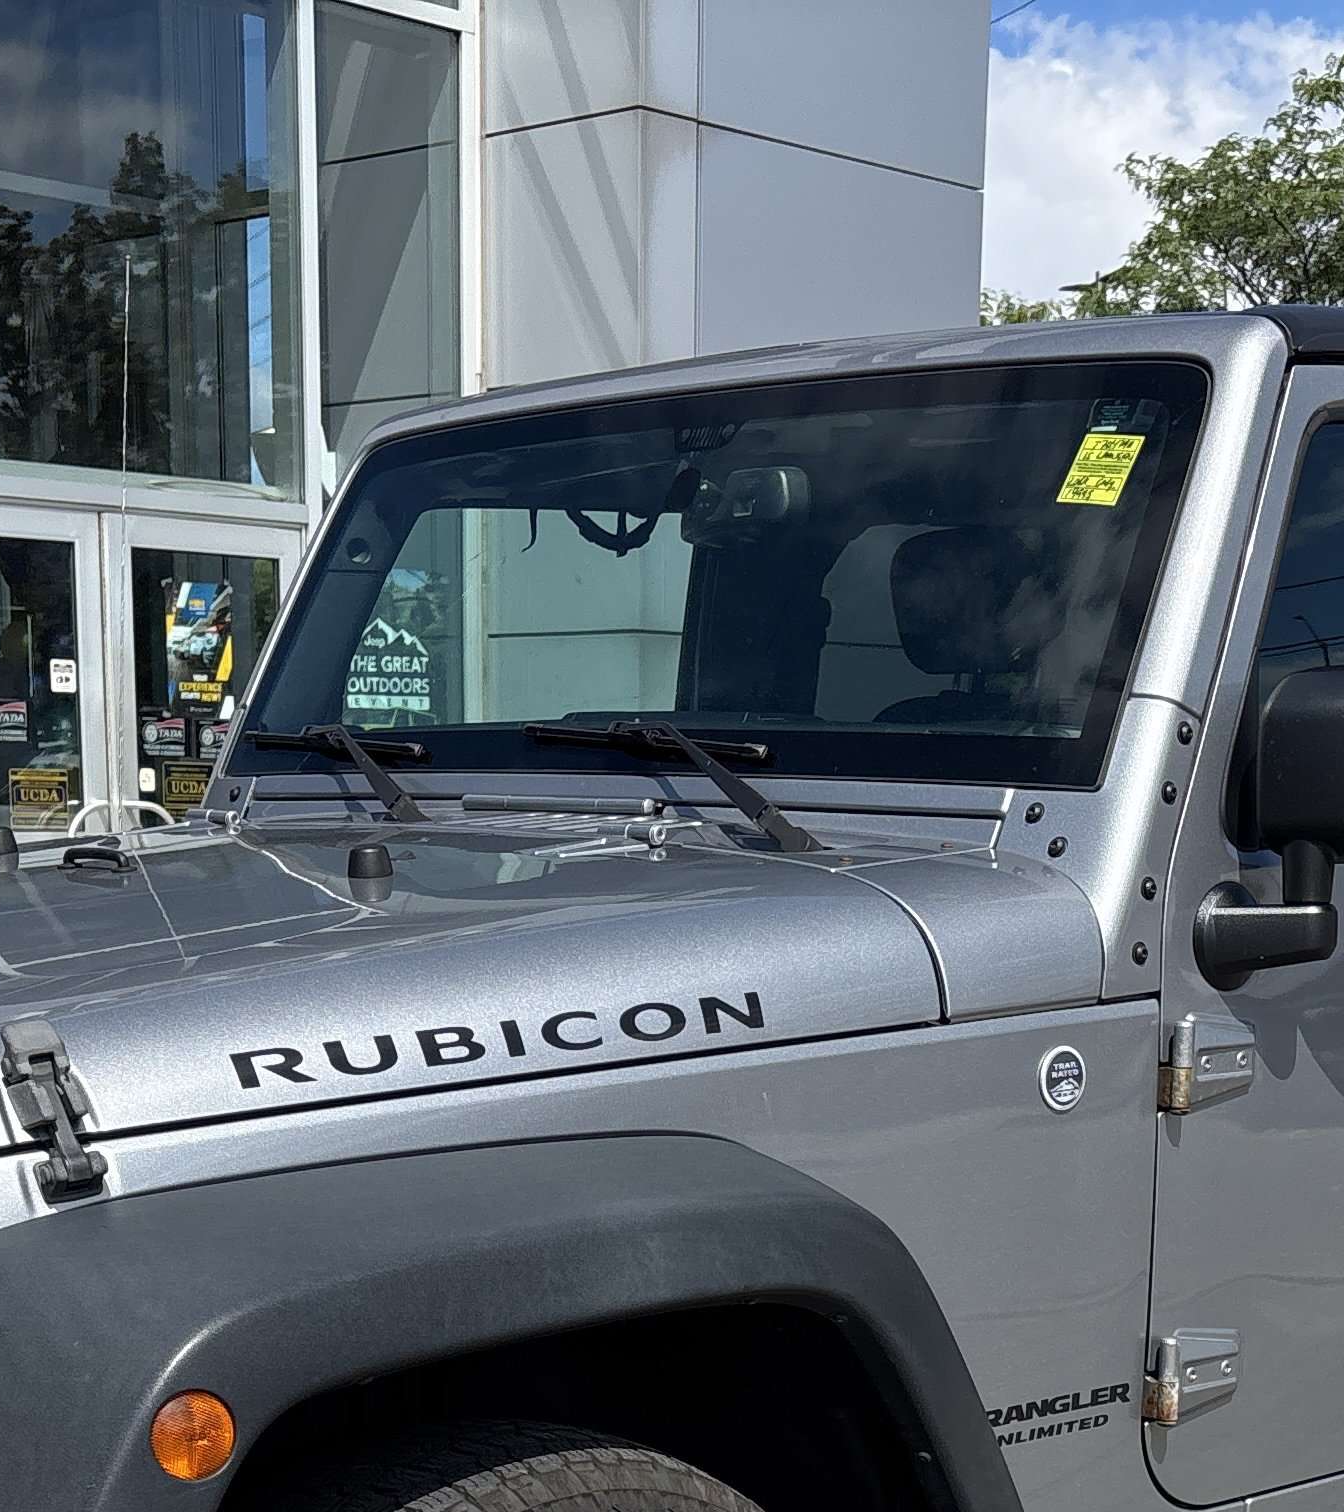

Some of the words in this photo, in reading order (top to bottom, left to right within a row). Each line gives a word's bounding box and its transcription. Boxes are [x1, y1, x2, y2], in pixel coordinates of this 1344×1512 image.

[364, 634, 386, 649] Jeep
[350, 654, 377, 672] THE
[380, 656, 429, 673] GREAT
[179, 682, 222, 691] EXPERIENCE
[347, 677, 430, 694] OUTDOORS
[20, 788, 61, 800] UCDA
[171, 781, 206, 793] UCDA
[229, 991, 765, 1089] RUBICON
[1053, 1061, 1078, 1071] TRAIL
[1051, 1069, 1080, 1079] RATED
[985, 1383, 1131, 1427] RANGLER
[997, 1414, 1109, 1447] NLIMITED
